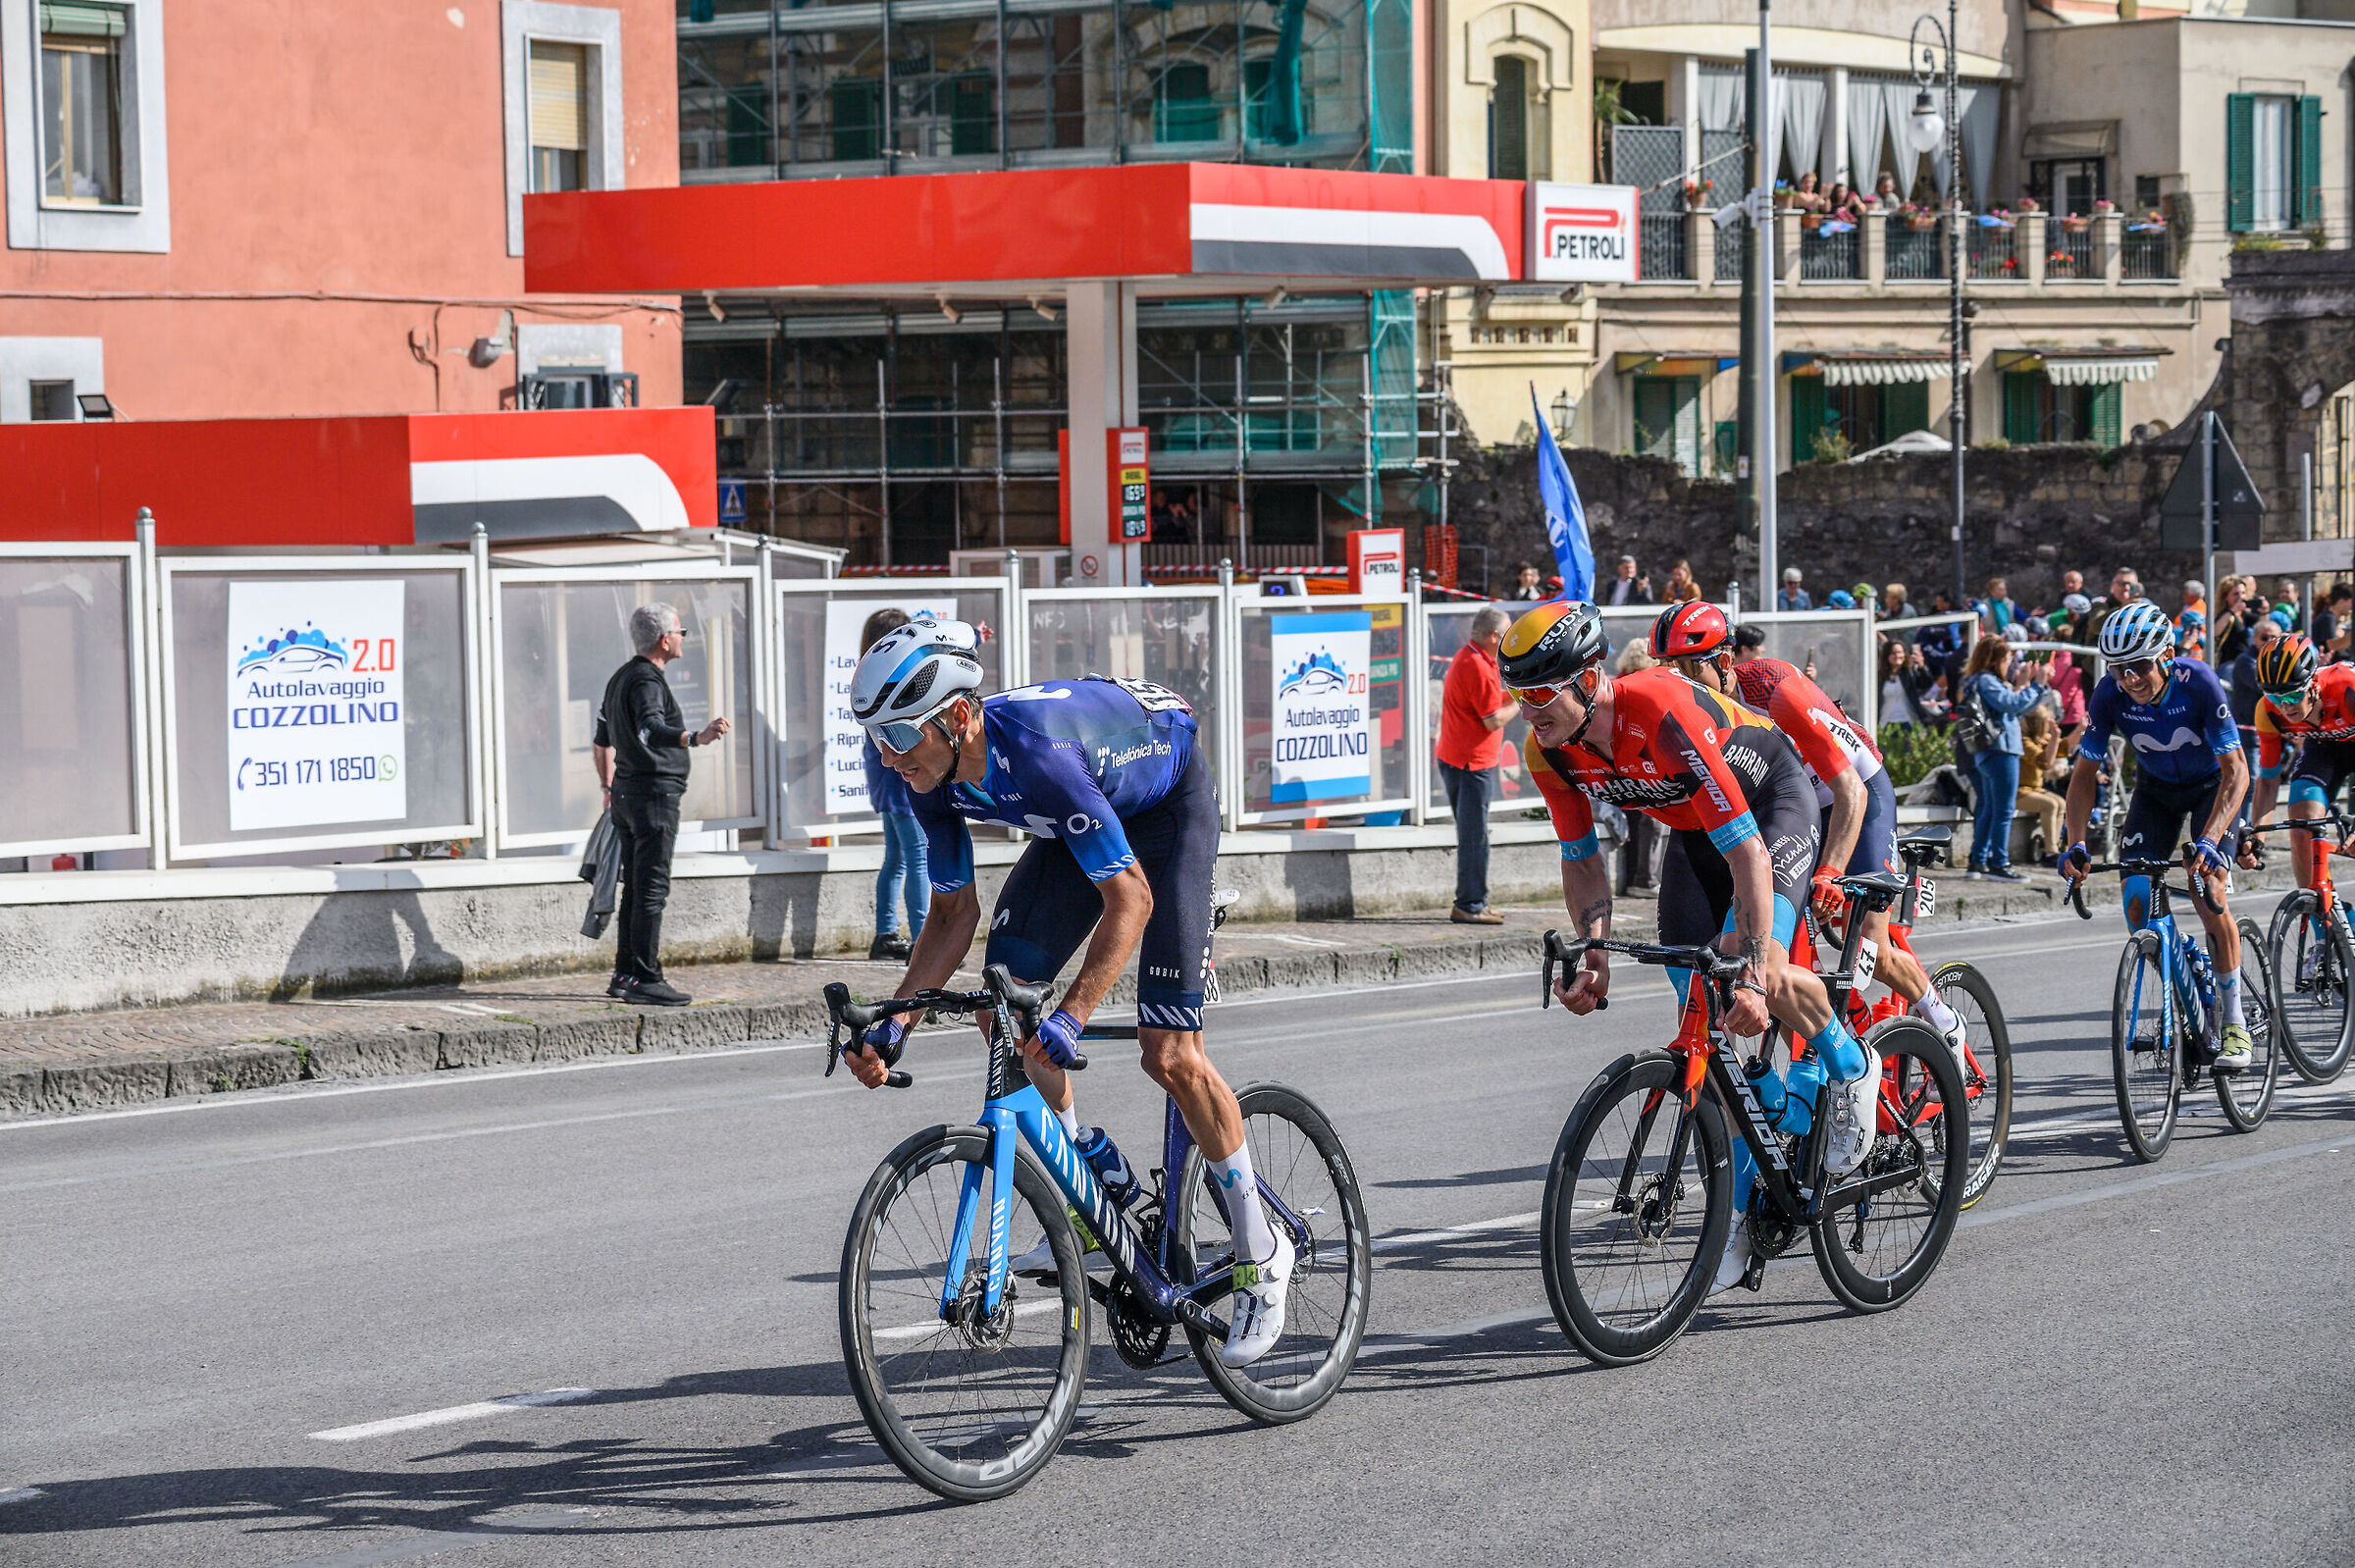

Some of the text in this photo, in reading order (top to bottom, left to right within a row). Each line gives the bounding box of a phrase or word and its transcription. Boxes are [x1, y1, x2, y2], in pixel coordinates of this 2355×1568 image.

[1556, 235, 1624, 260] PETROLI
[1538, 605, 1584, 652] RUDY
[1682, 604, 1711, 626] TREK
[352, 639, 394, 672] 2.0
[247, 677, 385, 700] Autolavaggio
[1347, 673, 1366, 695] 2.0
[234, 702, 398, 729] COZZOLINO
[1285, 705, 1360, 729] Autolavaggio
[1277, 732, 1368, 762] COZZOLINO
[1830, 722, 1861, 754] TREK
[1111, 739, 1172, 768] Telefónica Tech
[1723, 744, 1770, 788] BAHRAIN
[255, 757, 376, 786] 351 171 1850
[1680, 749, 1734, 812] MERIDA
[1769, 835, 1791, 857] USINESS
[1920, 879, 1935, 915] 205
[1149, 966, 1180, 979] GOBIK
[1858, 947, 1876, 978] 47
[1937, 971, 1963, 991] AEOLUS
[997, 1004, 1014, 1048] SRAM
[1138, 1003, 1203, 1027] ANY
[991, 1037, 1004, 1097] CANYON
[1710, 1030, 1789, 1171] MERIDA
[1884, 1098, 1909, 1129] MERIDA
[1040, 1106, 1136, 1275] CANYON
[988, 1197, 1006, 1293] CANYON
